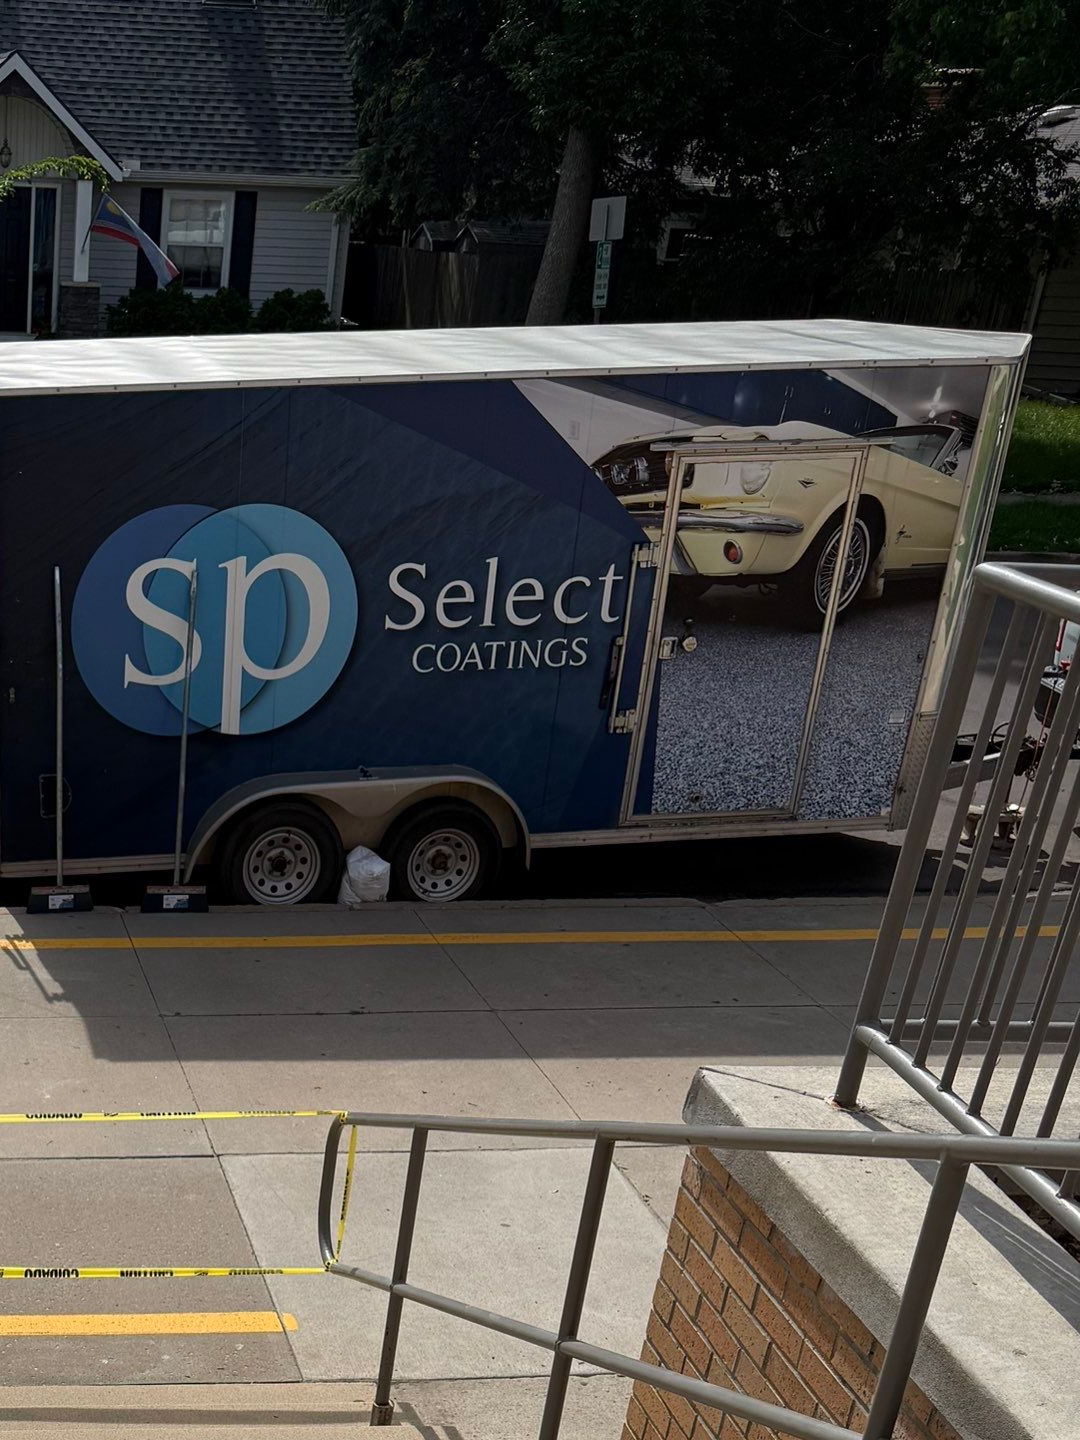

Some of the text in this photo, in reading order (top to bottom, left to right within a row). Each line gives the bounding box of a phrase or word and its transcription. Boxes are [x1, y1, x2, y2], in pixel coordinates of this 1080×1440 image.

[385, 556, 624, 632] Select
[412, 637, 589, 674] COATINGS
[24, 1268, 80, 1278] CUIDADO
